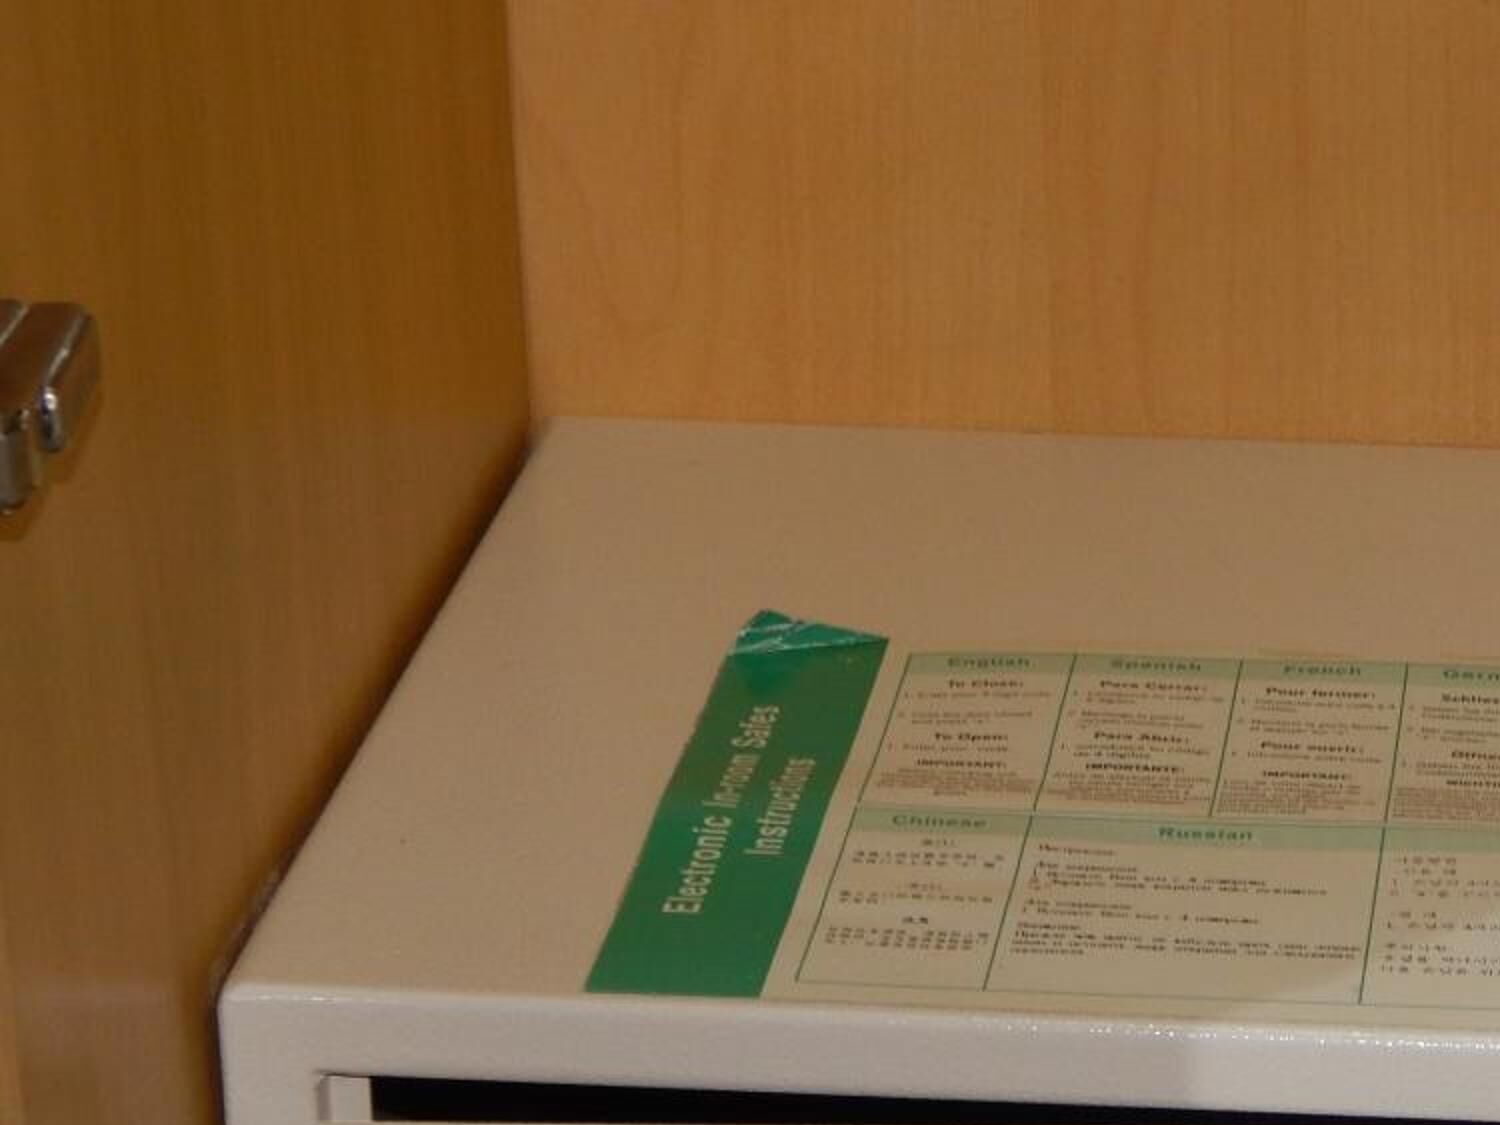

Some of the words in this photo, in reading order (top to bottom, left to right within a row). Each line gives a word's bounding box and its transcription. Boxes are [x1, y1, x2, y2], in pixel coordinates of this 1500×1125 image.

[948, 657, 1030, 669] English
[1111, 658, 1201, 671] Spanish
[1284, 665, 1361, 676] French
[744, 756, 816, 855] Instructions
[662, 815, 732, 913] Electronic
